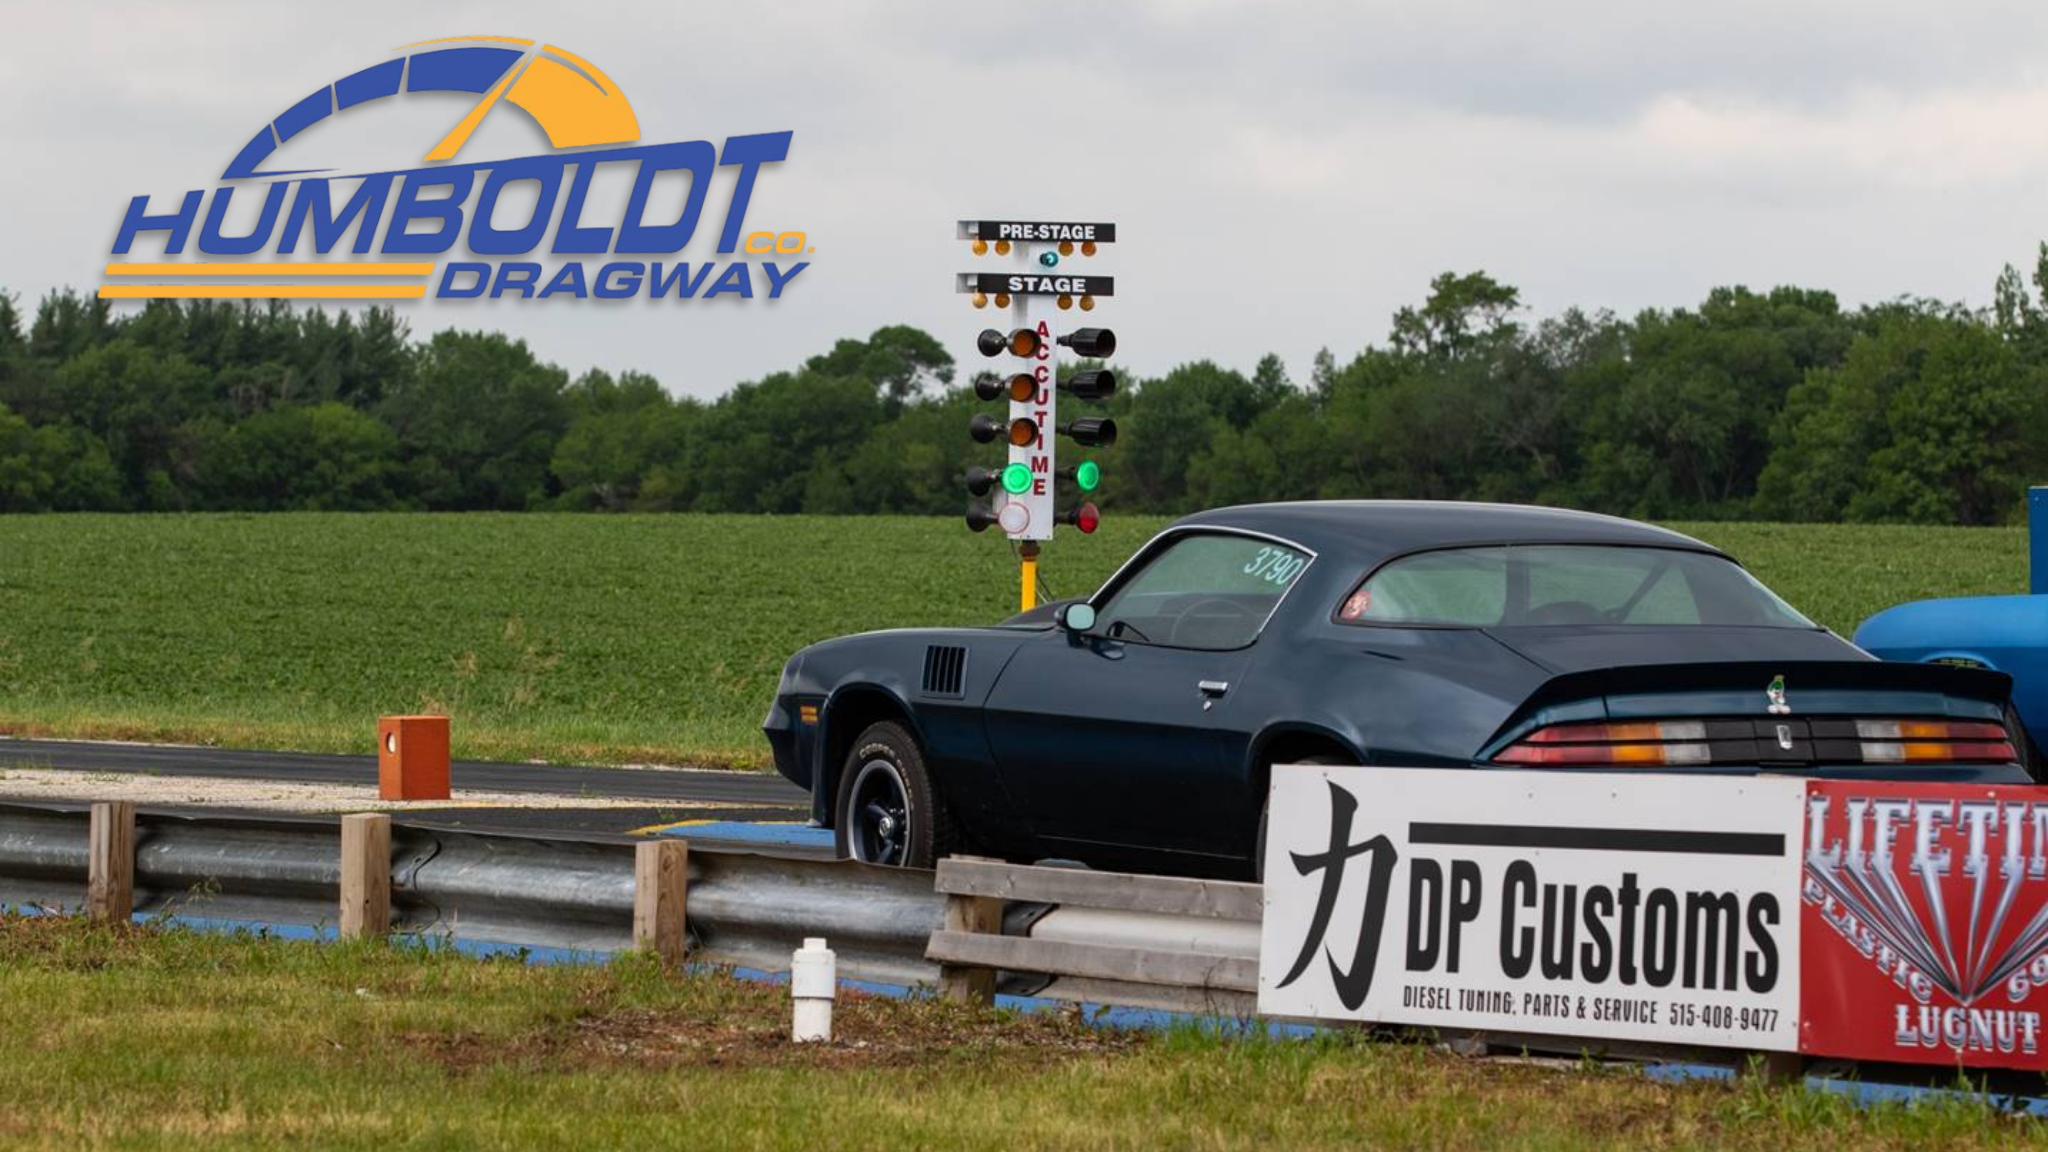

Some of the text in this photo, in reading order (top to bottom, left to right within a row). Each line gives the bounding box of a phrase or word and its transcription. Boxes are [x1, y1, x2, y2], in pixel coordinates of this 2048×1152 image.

[1000, 223, 1095, 241] PRE-STAGE
[1008, 276, 1087, 293] STAGE
[1031, 320, 1050, 496] ACCUTIME
[1244, 546, 1304, 585] 3790
[1275, 779, 1398, 1011] 力
[1405, 857, 1781, 994] DP Customs
[1800, 876, 1932, 1004] PLASTIC
[1403, 985, 1452, 1011] DIESEL
[1523, 993, 1570, 1019] PARTS
[1576, 996, 1586, 1020] &
[1593, 998, 1658, 1024] SERVICE
[1669, 1002, 1779, 1032] 515-408-9477
[1895, 1003, 2042, 1054] LUGNUT
